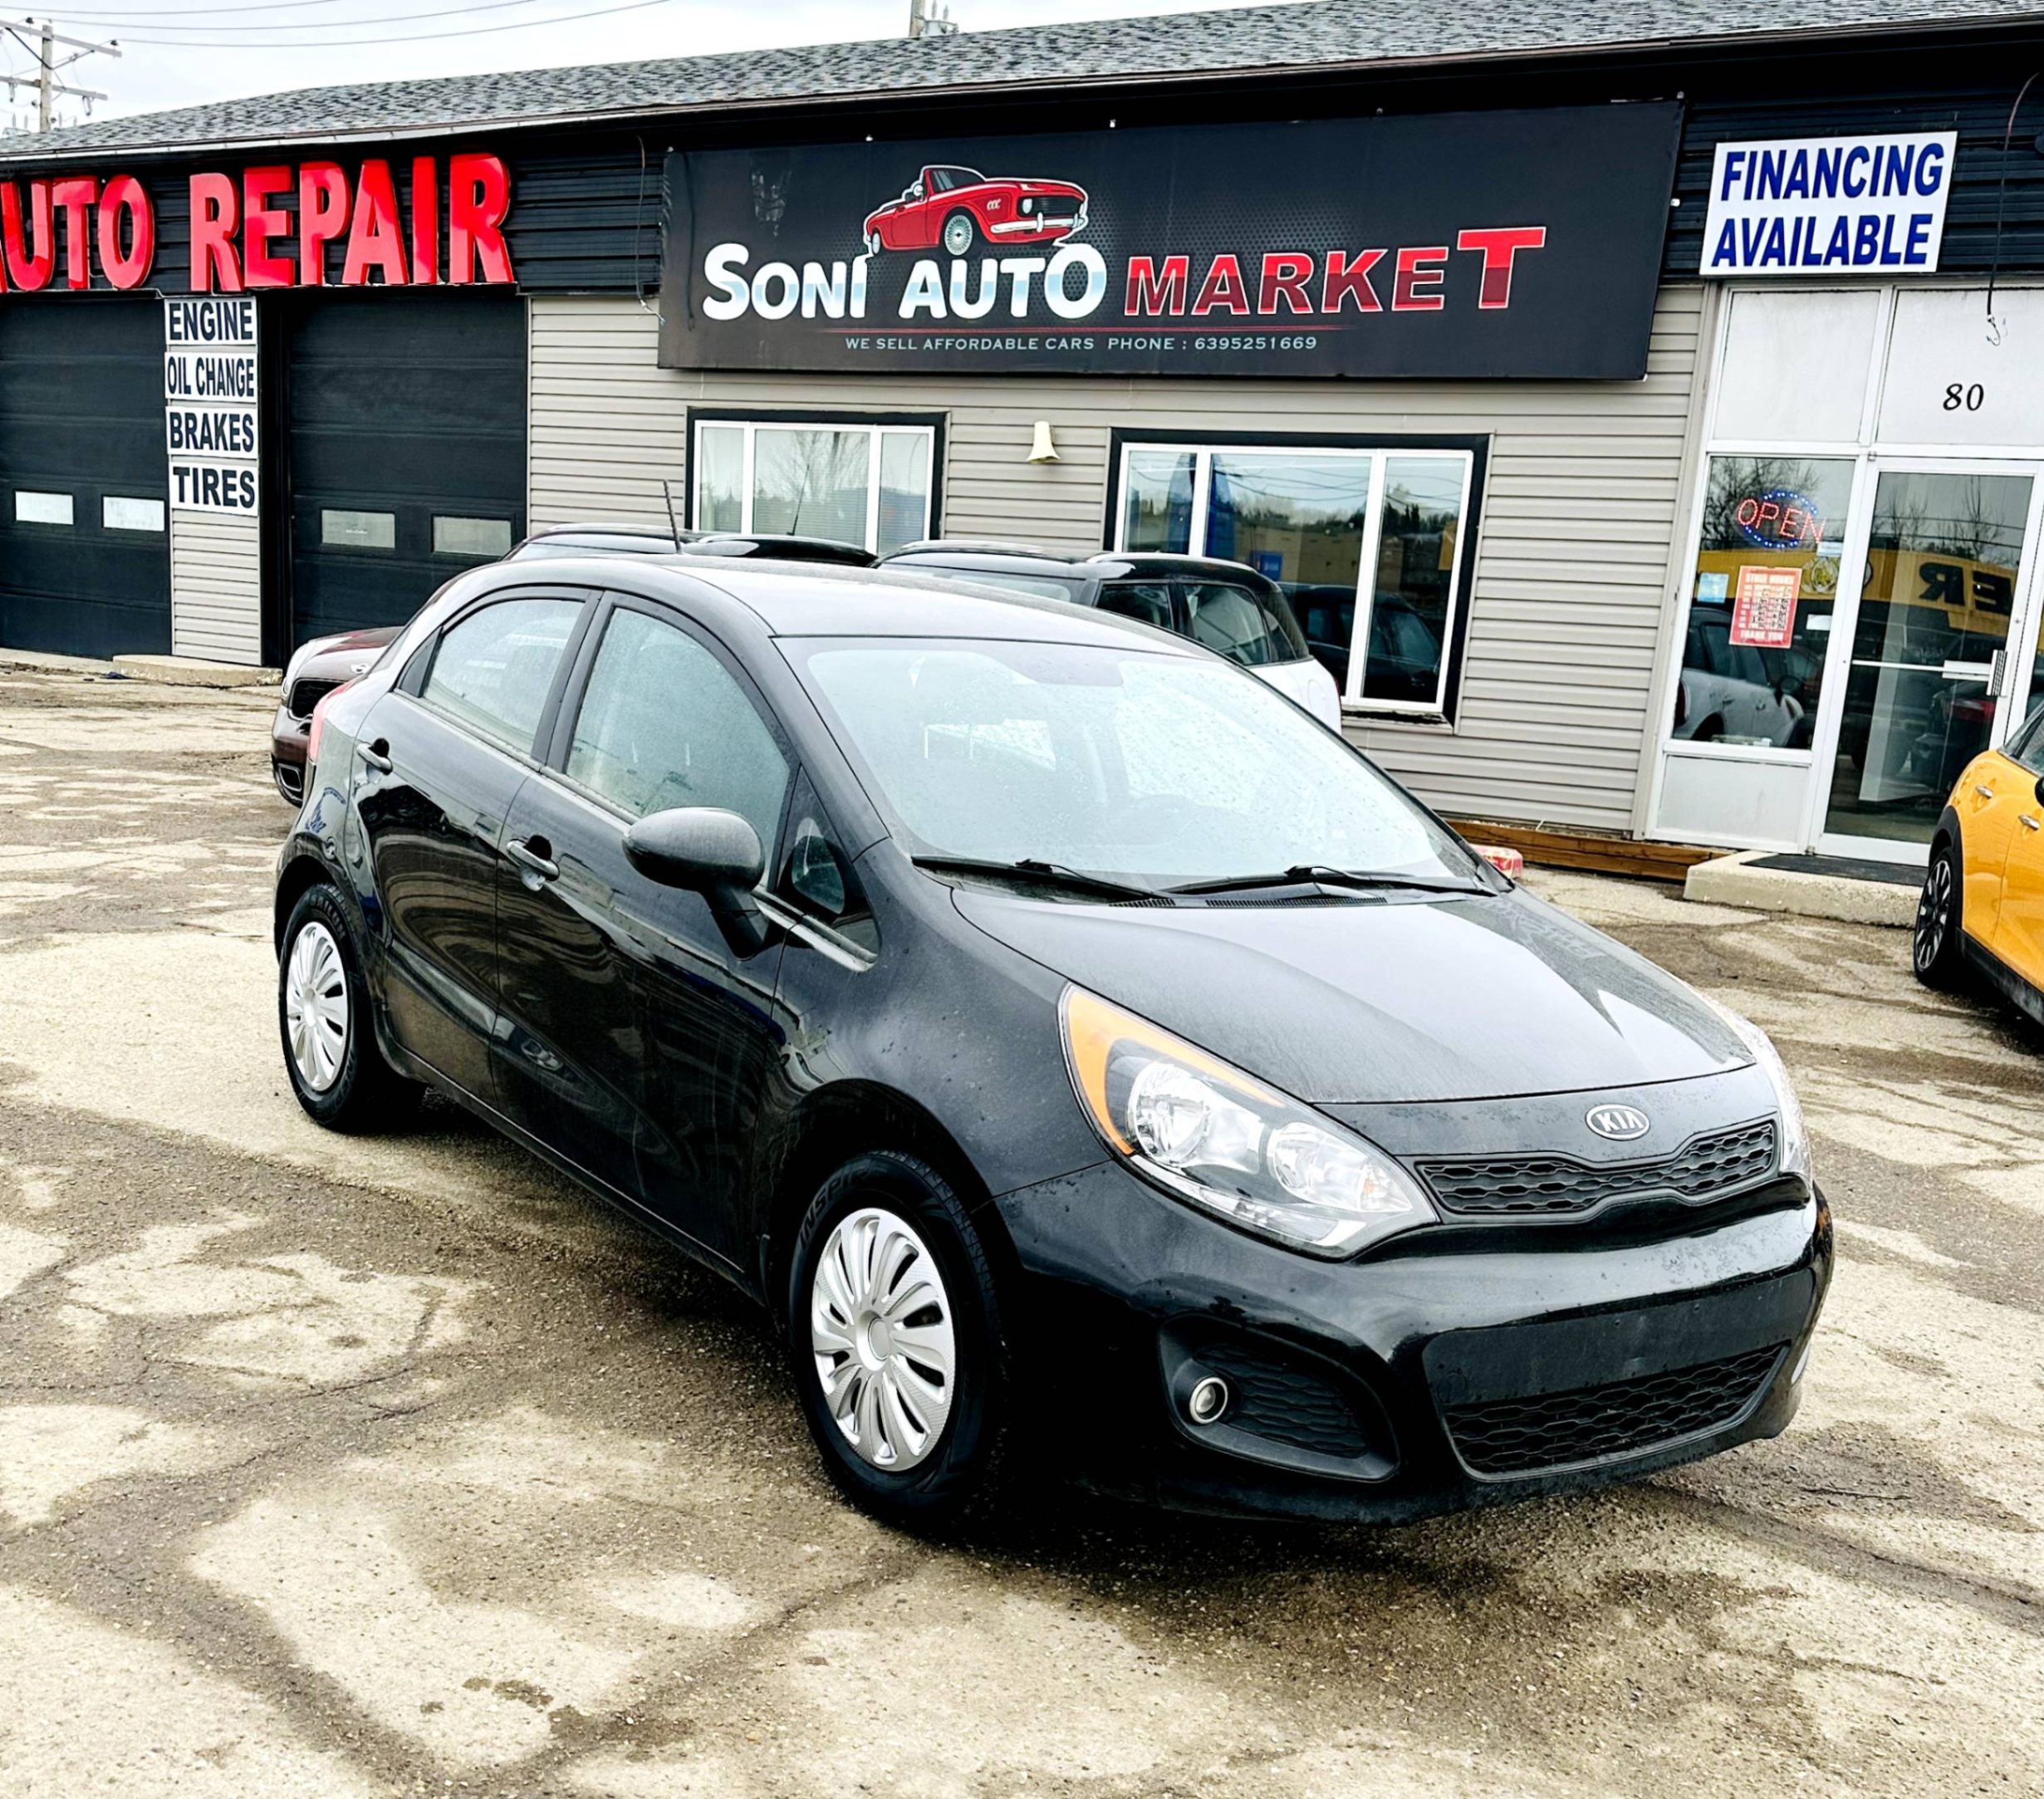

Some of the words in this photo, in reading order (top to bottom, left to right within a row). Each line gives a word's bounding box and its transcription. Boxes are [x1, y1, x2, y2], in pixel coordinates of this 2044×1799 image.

[1721, 142, 1945, 202] FINANCING
[0, 174, 155, 293] UTO
[189, 153, 515, 293] REPAIR
[1711, 213, 1934, 267] AVAILABLE
[703, 243, 869, 321] SONI
[898, 243, 1107, 320] AUTO
[1123, 226, 1547, 317] MARKET
[169, 301, 253, 341] ENGINE
[846, 337, 870, 350] WE
[876, 337, 918, 350] SELL
[923, 337, 1039, 350] AFFORDABLE
[1045, 337, 1095, 350] CARS
[1107, 337, 1175, 350] PHONE
[1194, 336, 1317, 350] 6395251669
[168, 355, 192, 395] OIL
[196, 356, 254, 397] CHANGE
[1943, 383, 1985, 411] 80
[169, 411, 254, 453] BRAKES
[173, 466, 256, 509] TIRES
[1738, 498, 1826, 544] OPEN
[1595, 1110, 1645, 1132] KIA
